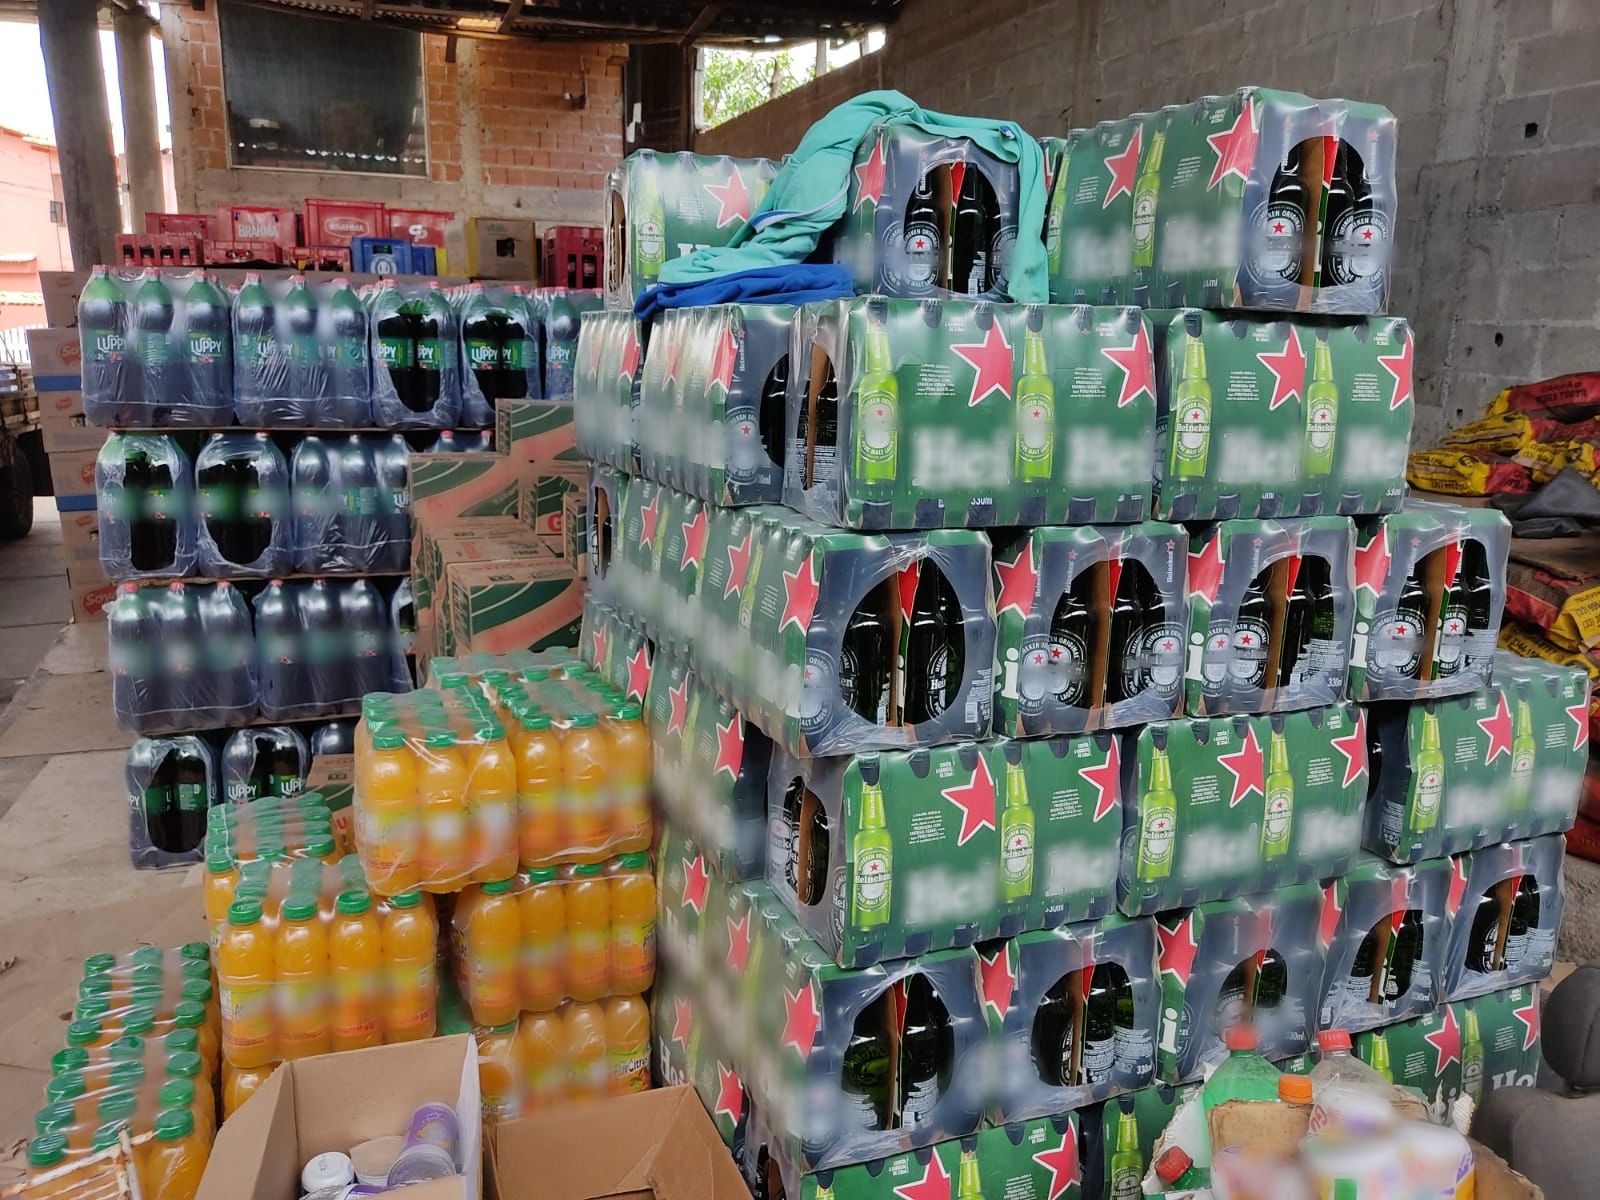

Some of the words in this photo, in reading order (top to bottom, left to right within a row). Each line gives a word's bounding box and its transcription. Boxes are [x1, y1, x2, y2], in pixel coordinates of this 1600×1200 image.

[238, 223, 279, 238] BRAHMA
[191, 335, 222, 355] LUPPY
[1176, 423, 1210, 432] Heineken
[228, 784, 257, 800] LUPPY
[855, 872, 891, 884] Heineken
